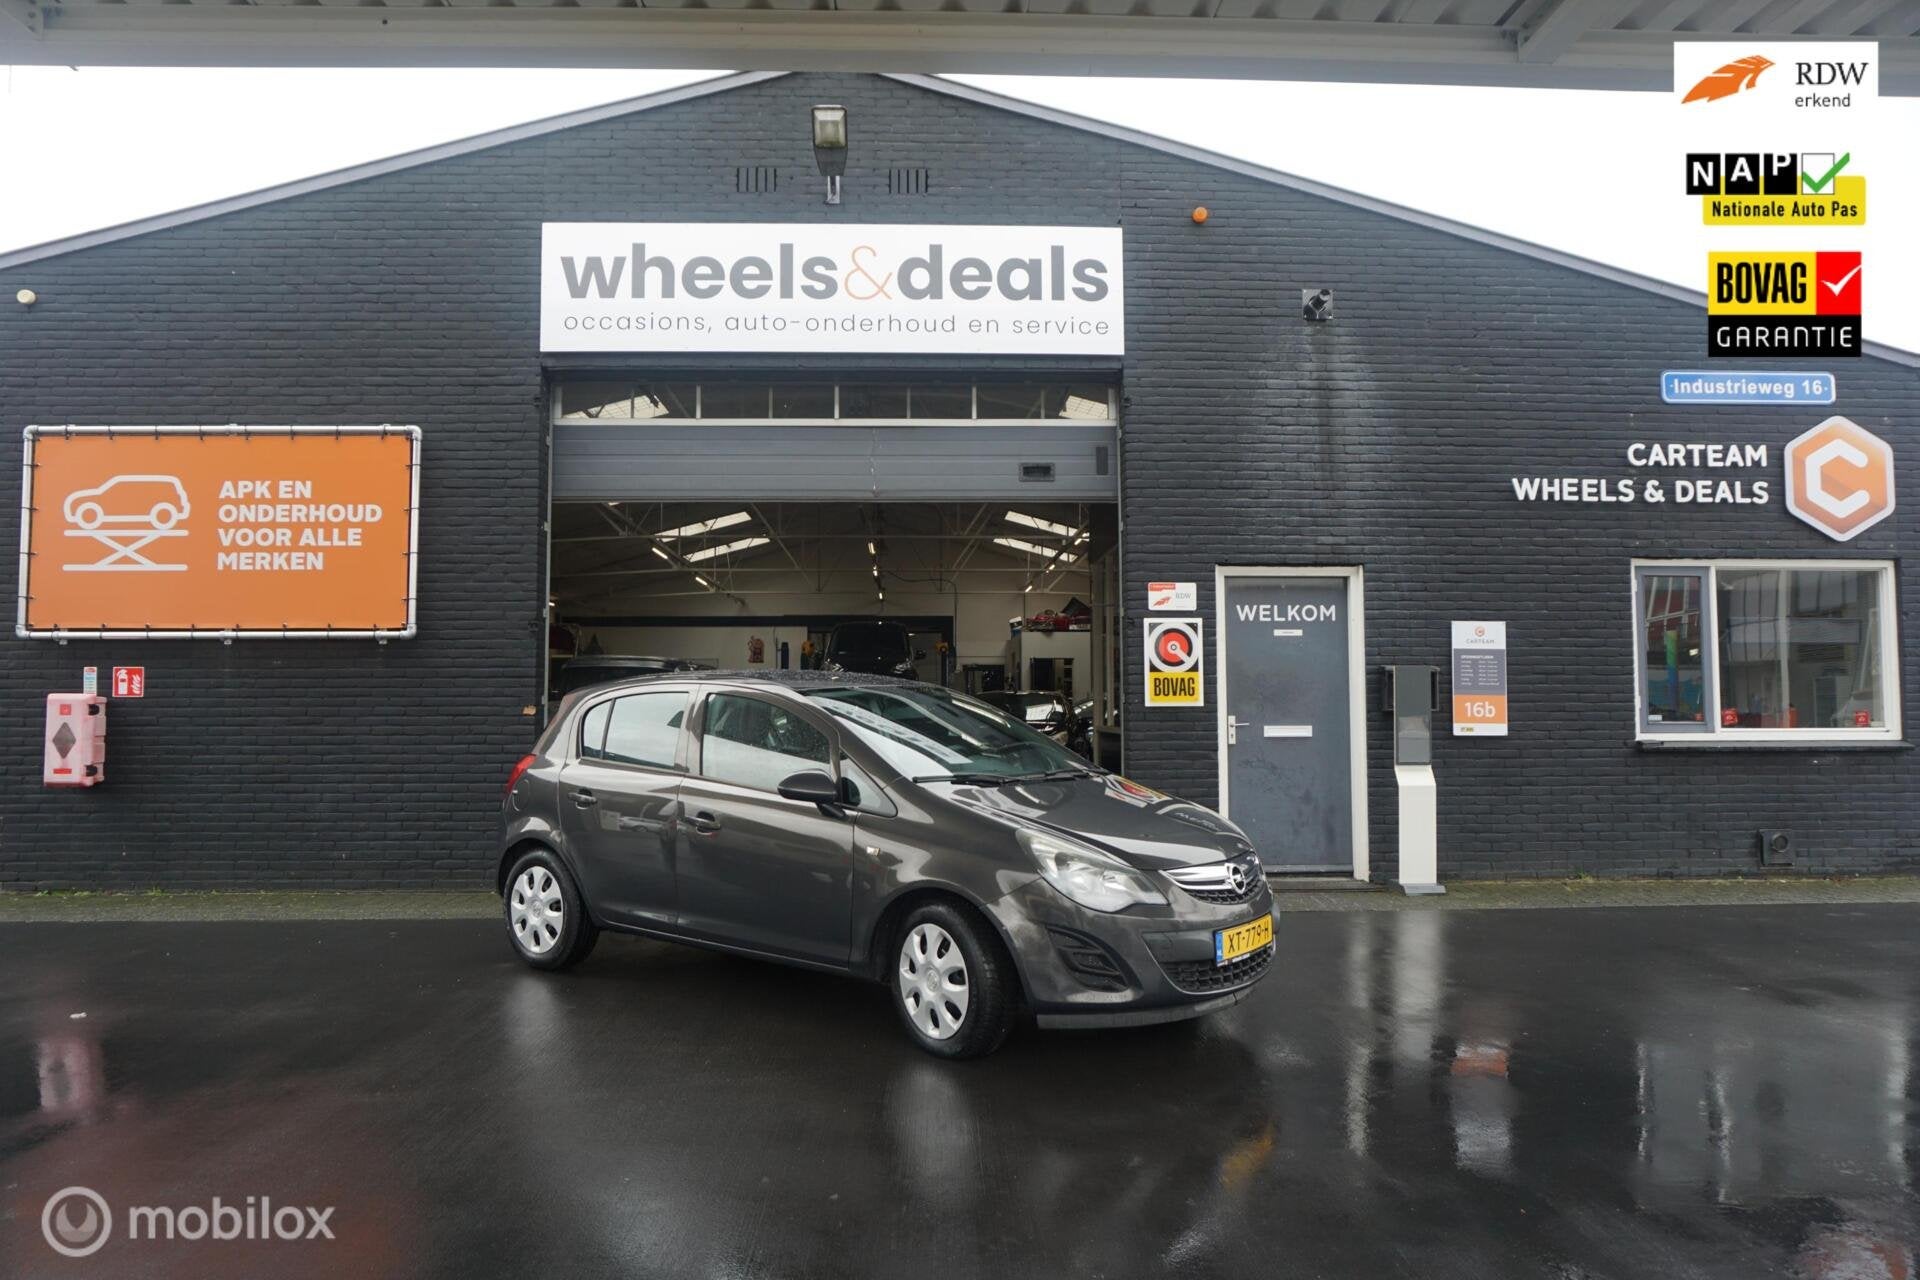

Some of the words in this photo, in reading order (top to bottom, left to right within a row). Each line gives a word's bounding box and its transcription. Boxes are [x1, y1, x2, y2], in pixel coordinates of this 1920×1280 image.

[564, 312, 713, 333] occasions,
[725, 313, 956, 333] auto-onderhoud
[968, 317, 1000, 333] en
[1012, 316, 1109, 335] service
[1673, 378, 1795, 399] Industrieweg
[1627, 443, 1768, 468] CARTEAM
[218, 480, 271, 499] APK
[279, 480, 312, 499] EN
[1511, 478, 1635, 502] WHEELS
[1644, 479, 1665, 503] &
[1675, 480, 1769, 504] DEALS
[217, 504, 383, 523] ONDERHOUD
[218, 528, 292, 547] VOOR
[298, 528, 362, 547] ALLE
[217, 552, 323, 570] MERKEN
[1236, 604, 1336, 622] WELKOM
[1153, 677, 1196, 697] BOVAG
[1464, 701, 1496, 718] 16b
[1227, 918, 1270, 954] XT-779-H
